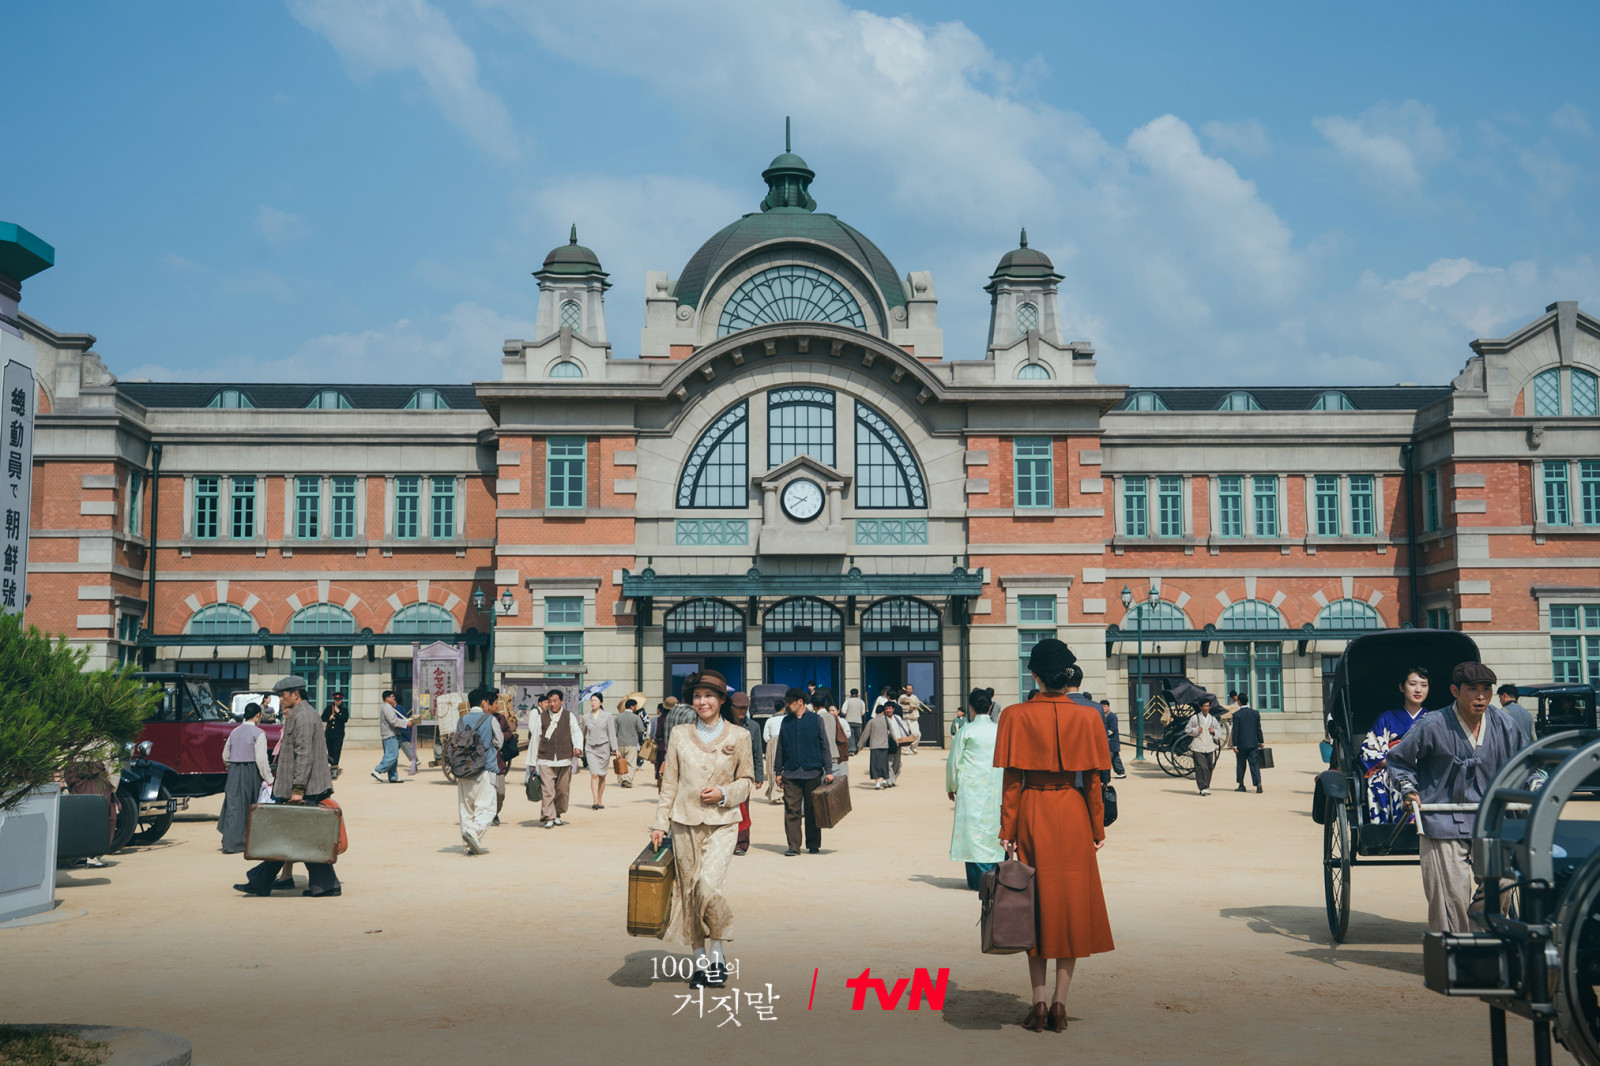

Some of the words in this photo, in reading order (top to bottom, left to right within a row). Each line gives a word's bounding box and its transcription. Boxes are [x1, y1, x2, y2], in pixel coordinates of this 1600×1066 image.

[2, 387, 26, 616] 總動員で朝鮮號
